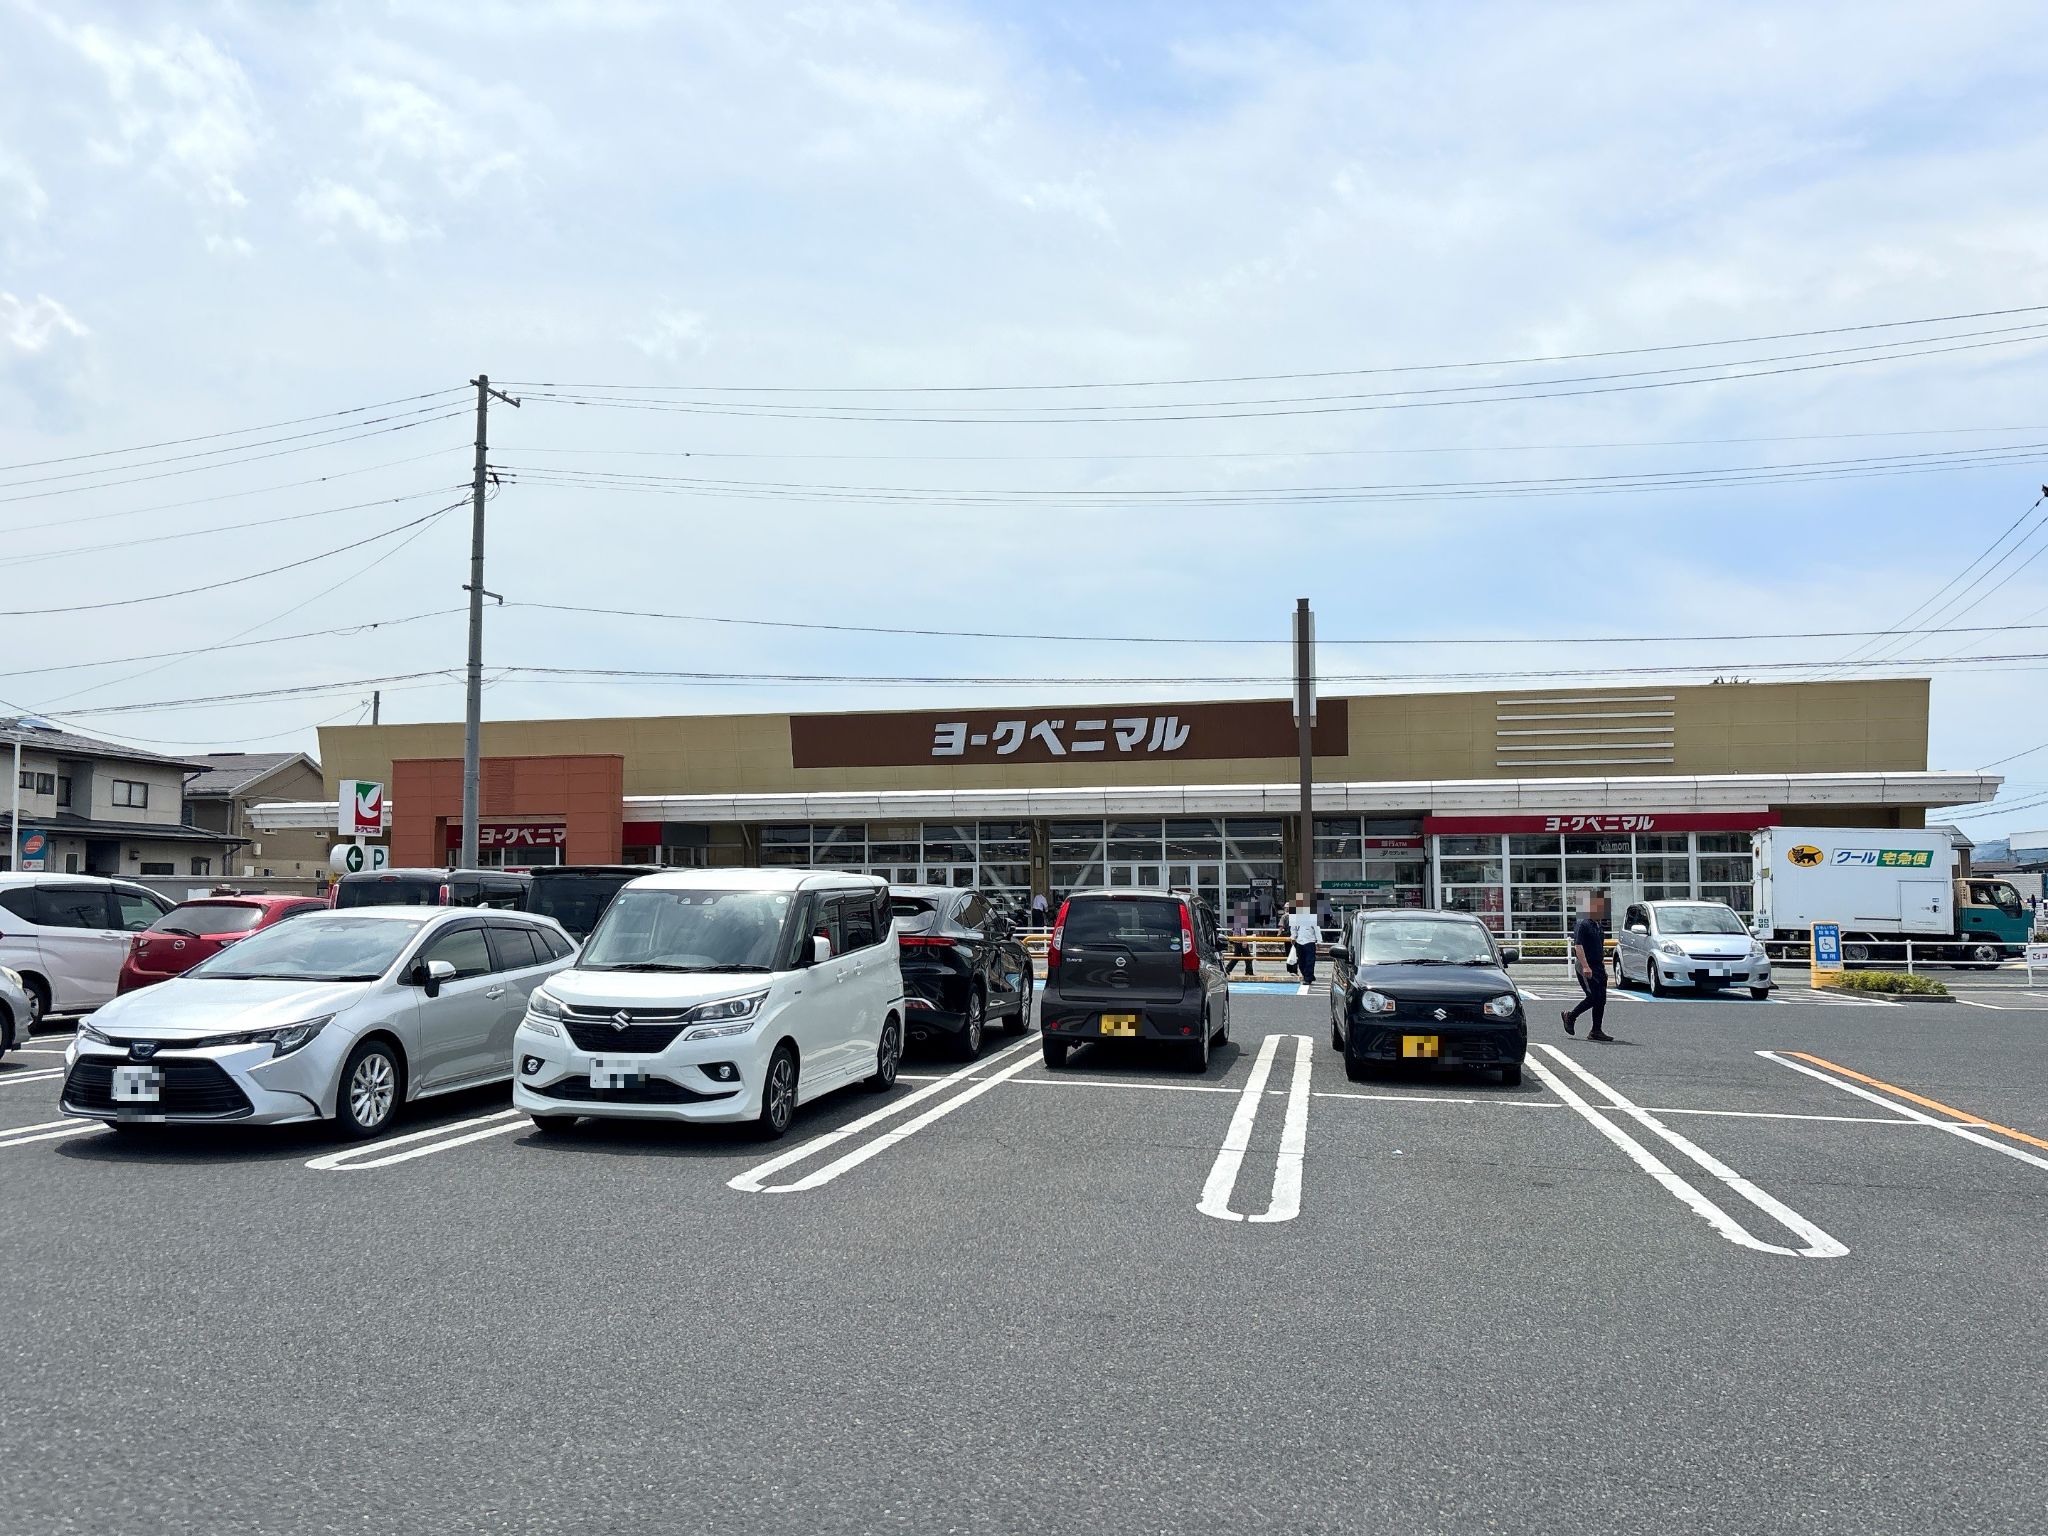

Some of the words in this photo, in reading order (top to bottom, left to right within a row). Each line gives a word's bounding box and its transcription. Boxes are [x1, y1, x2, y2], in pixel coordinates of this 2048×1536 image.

[931, 716, 1190, 756] ヨークベニマル
[1544, 815, 1655, 832] ヨークベニマル
[373, 848, 384, 870] P
